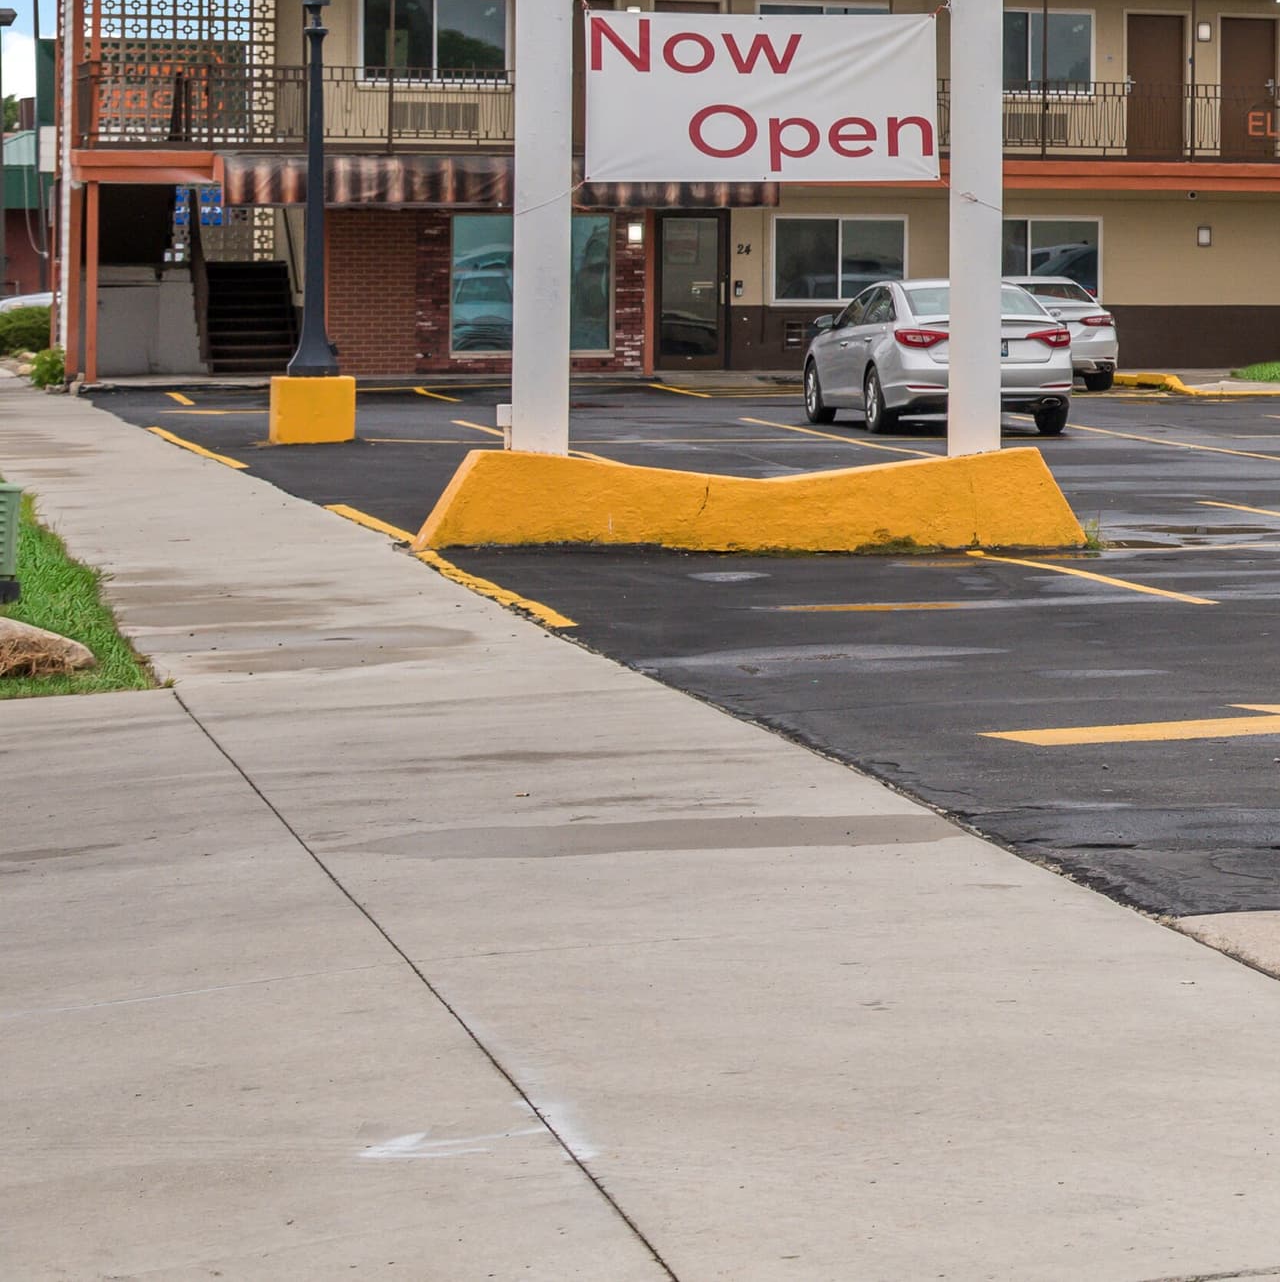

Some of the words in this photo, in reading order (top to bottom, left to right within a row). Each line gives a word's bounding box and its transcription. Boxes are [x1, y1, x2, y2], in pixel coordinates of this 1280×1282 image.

[590, 16, 803, 75] Now
[688, 103, 934, 173] Open
[736, 243, 752, 255] 24
